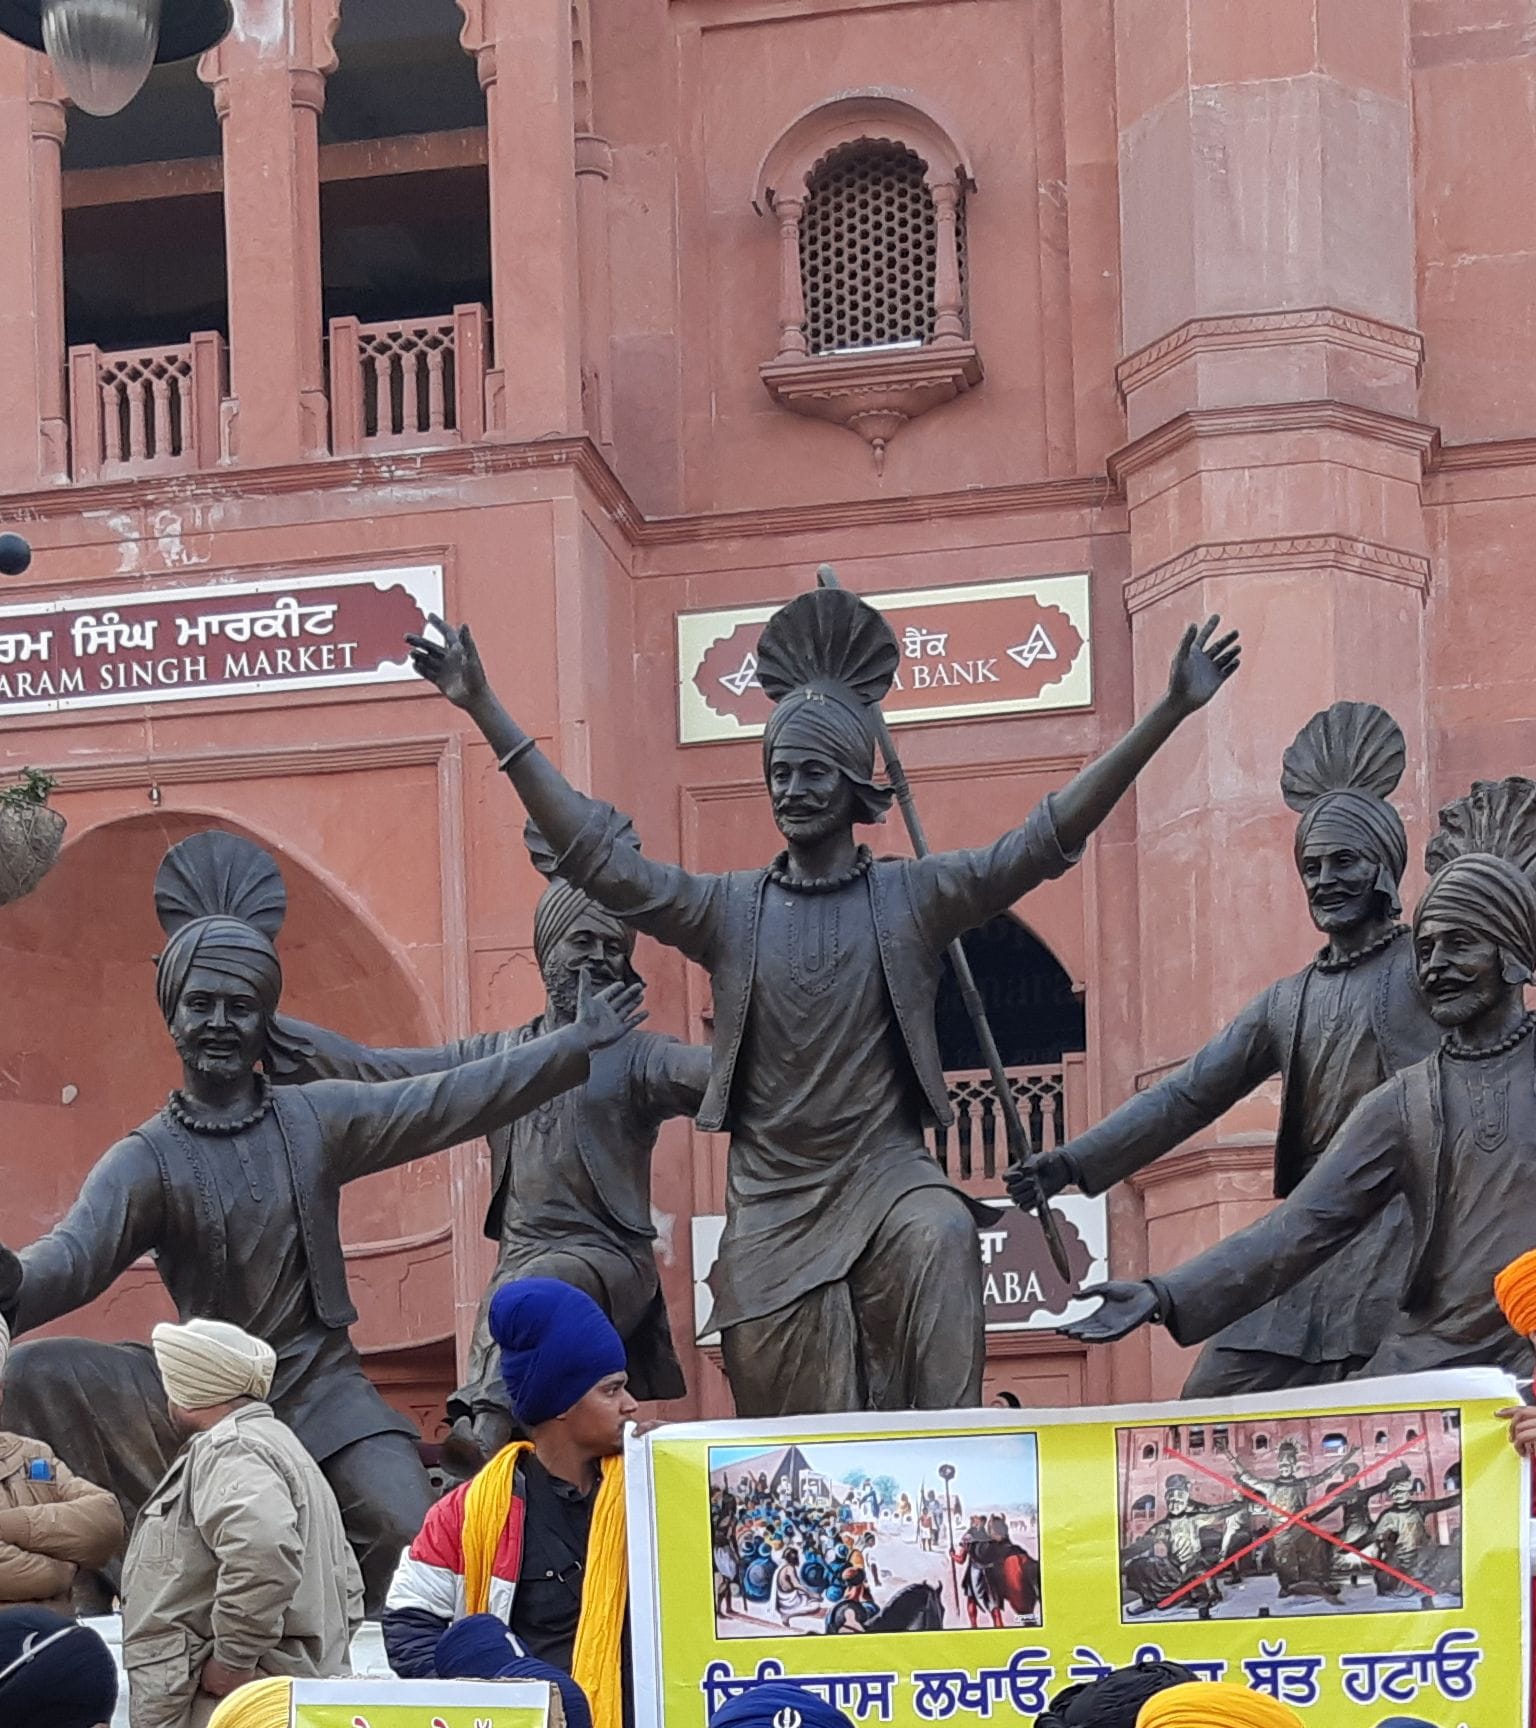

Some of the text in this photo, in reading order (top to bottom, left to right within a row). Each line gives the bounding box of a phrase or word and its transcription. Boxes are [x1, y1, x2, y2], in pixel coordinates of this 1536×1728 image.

[71, 612, 156, 656] ਸਿੰਘ
[177, 597, 338, 645] ਮਾਰਕੀਟ
[903, 627, 948, 658] ਬੈਂਕ
[99, 655, 207, 688] SINGH
[224, 642, 358, 679] MARKET
[912, 658, 999, 689] BANK
